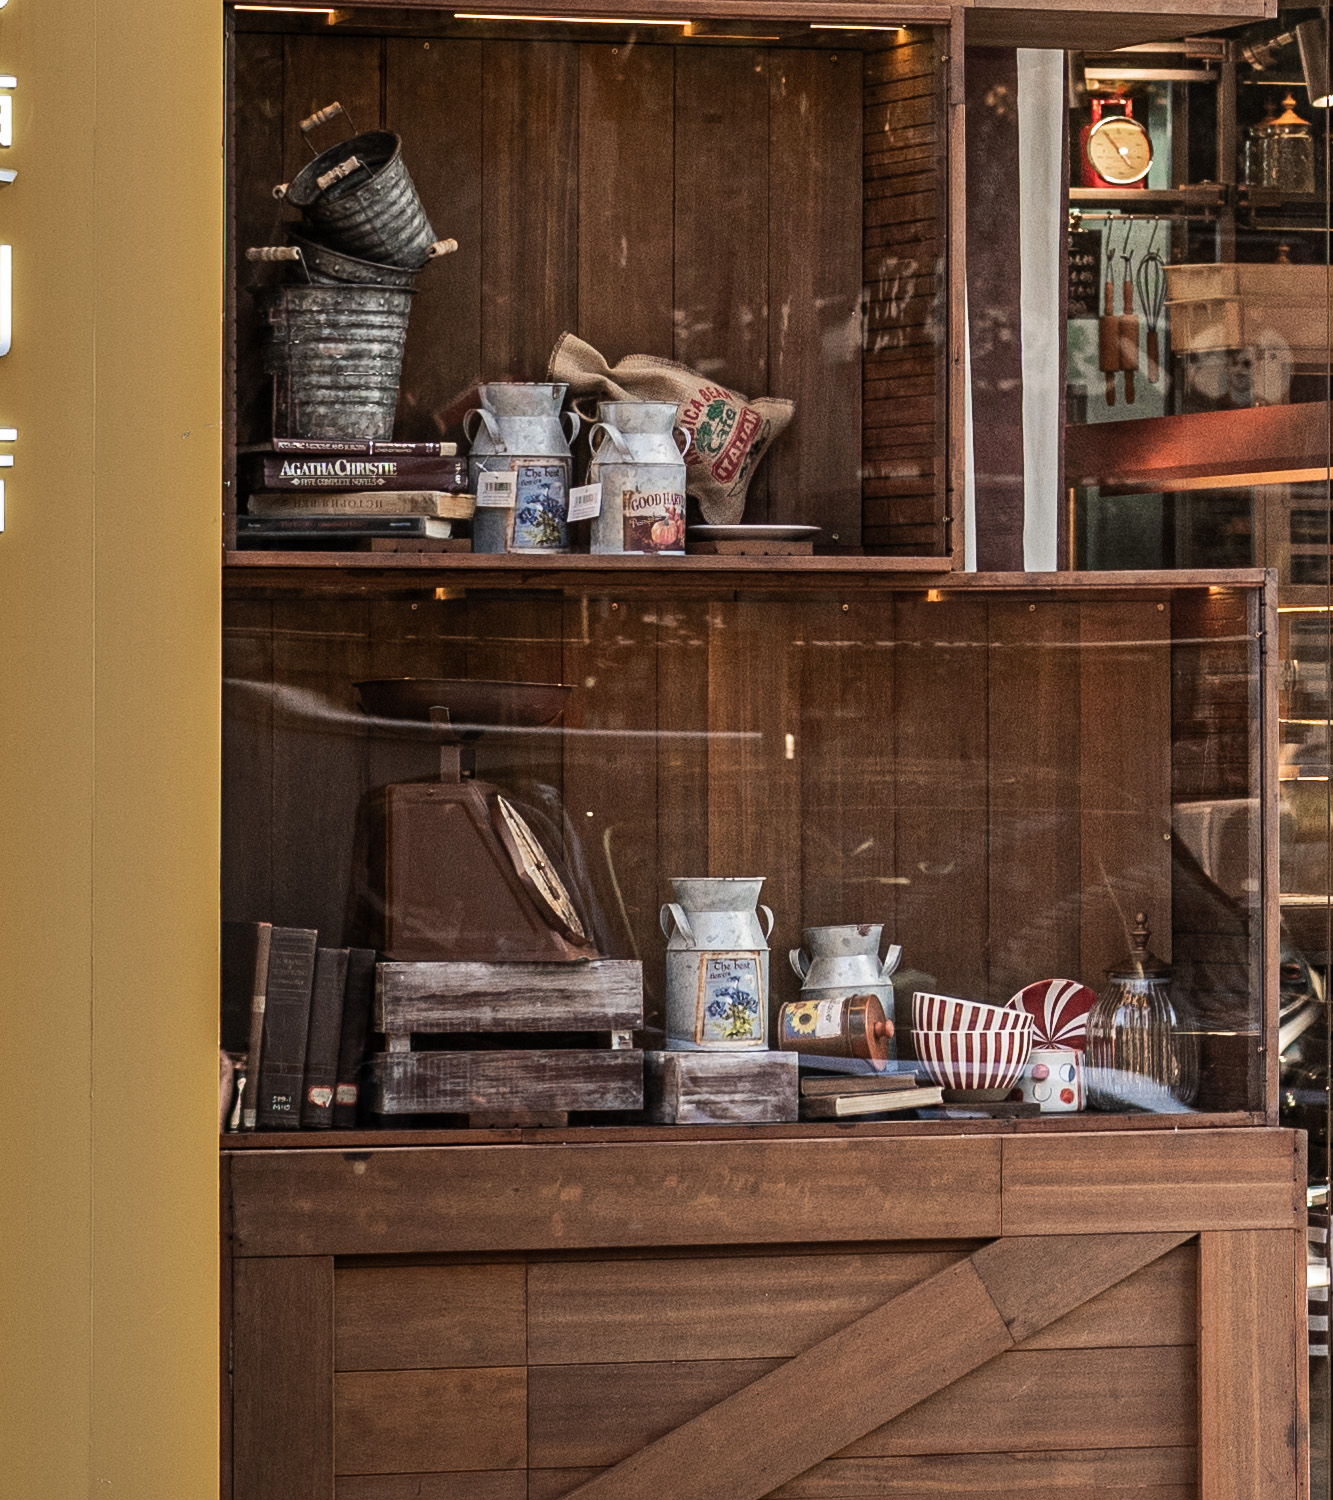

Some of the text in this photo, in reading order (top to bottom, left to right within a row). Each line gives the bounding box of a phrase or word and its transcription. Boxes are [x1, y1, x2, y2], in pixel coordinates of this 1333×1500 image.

[280, 459, 398, 477] AGATHA CHRISTIE
[631, 493, 662, 512] GOOD
